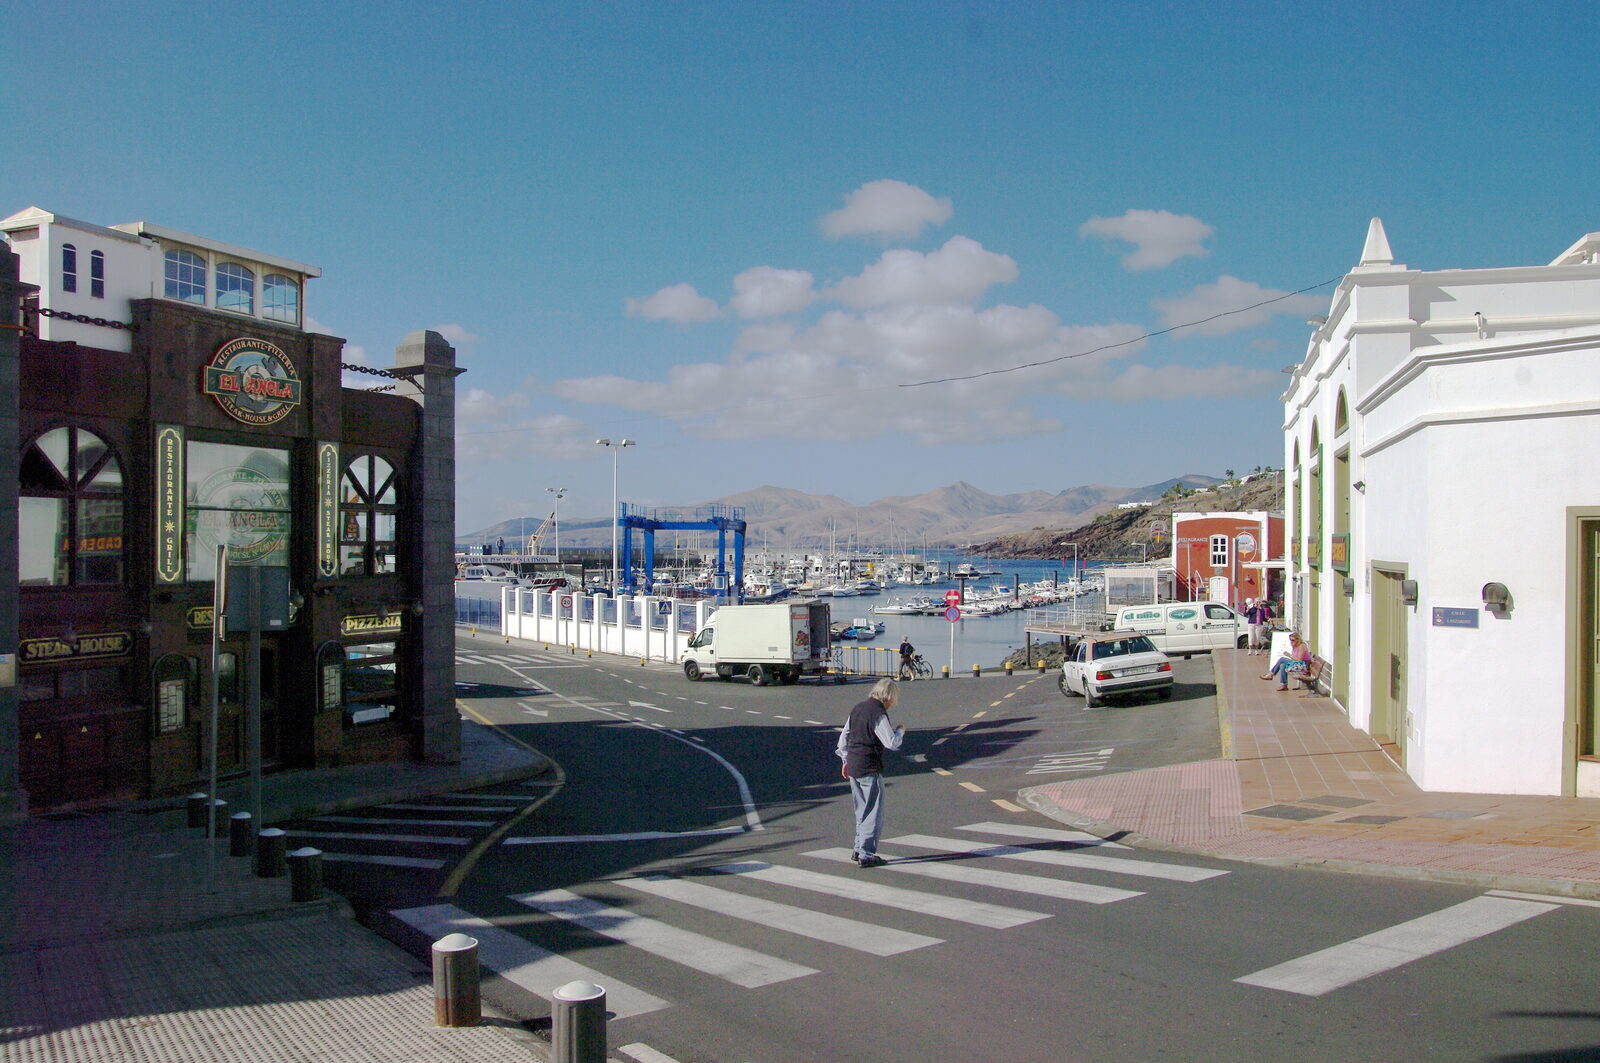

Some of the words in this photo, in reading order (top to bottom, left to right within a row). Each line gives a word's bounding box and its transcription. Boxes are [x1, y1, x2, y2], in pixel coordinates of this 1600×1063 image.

[219, 373, 241, 392] EL
[244, 376, 293, 399] ANCLA
[166, 438, 174, 516] RESTAURANTE
[166, 537, 174, 573] GRILL
[345, 615, 401, 631] PIZZERIA
[79, 636, 123, 653] HOUSE
